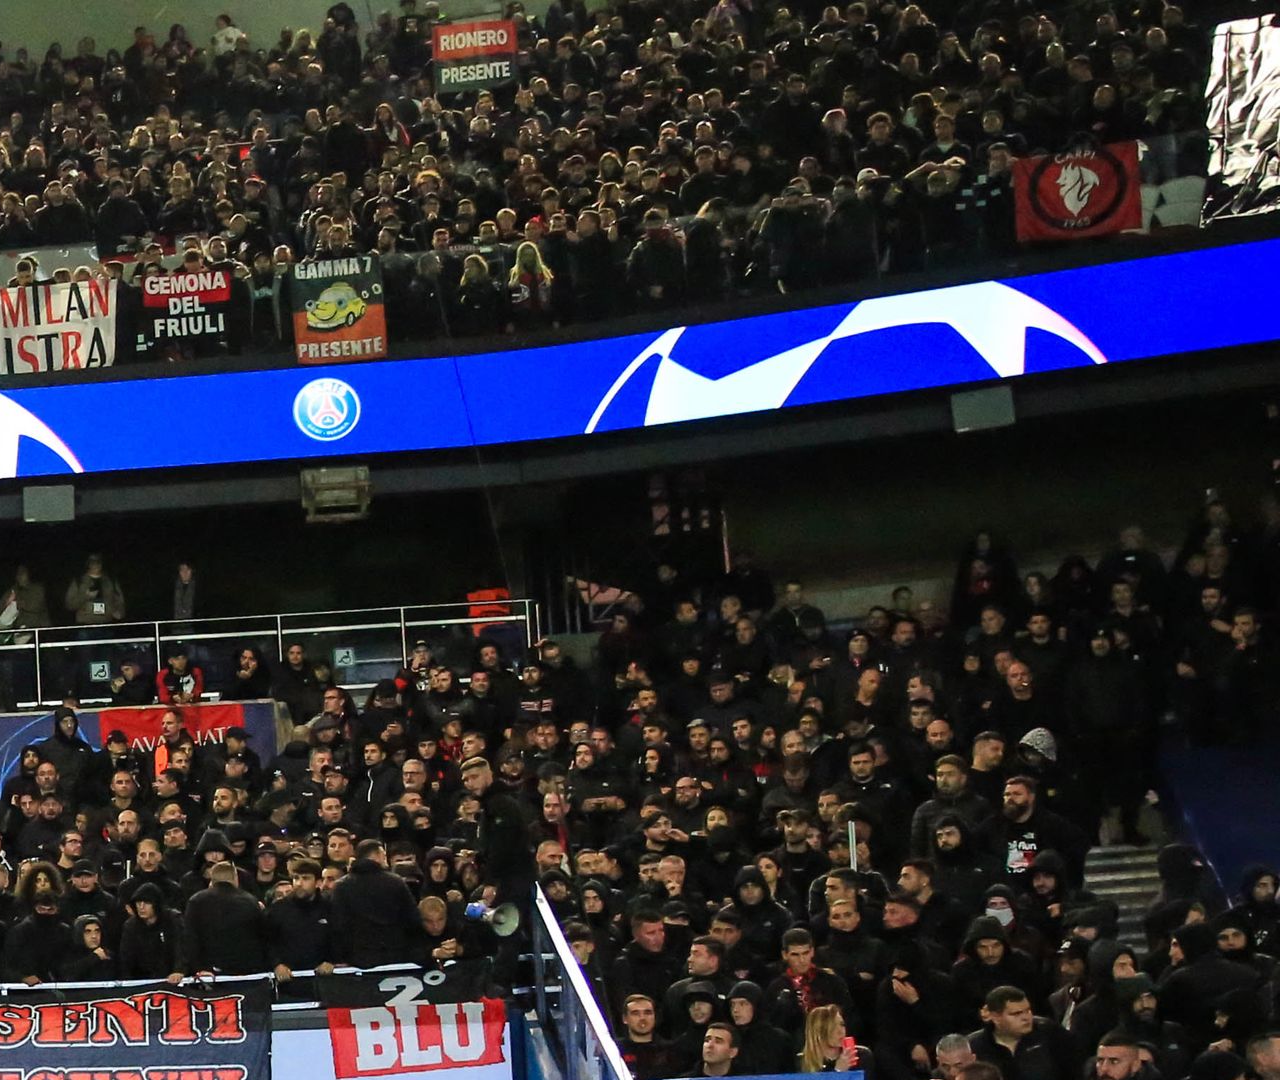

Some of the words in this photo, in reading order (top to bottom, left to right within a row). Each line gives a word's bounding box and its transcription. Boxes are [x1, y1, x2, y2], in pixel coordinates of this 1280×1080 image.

[440, 29, 508, 51] RIONERO
[441, 61, 511, 84] PRESENTE
[1055, 151, 1096, 164] CARPI
[294, 257, 361, 280] GAMMA
[362, 256, 372, 273] 7
[143, 271, 227, 295] GEMONA
[0, 279, 111, 328] MILAN
[168, 296, 206, 315] DEL
[153, 313, 225, 339] FRIULI
[4, 327, 108, 375] ISTRA
[298, 336, 383, 359] PRESENTE
[350, 1001, 487, 1071] BLU
